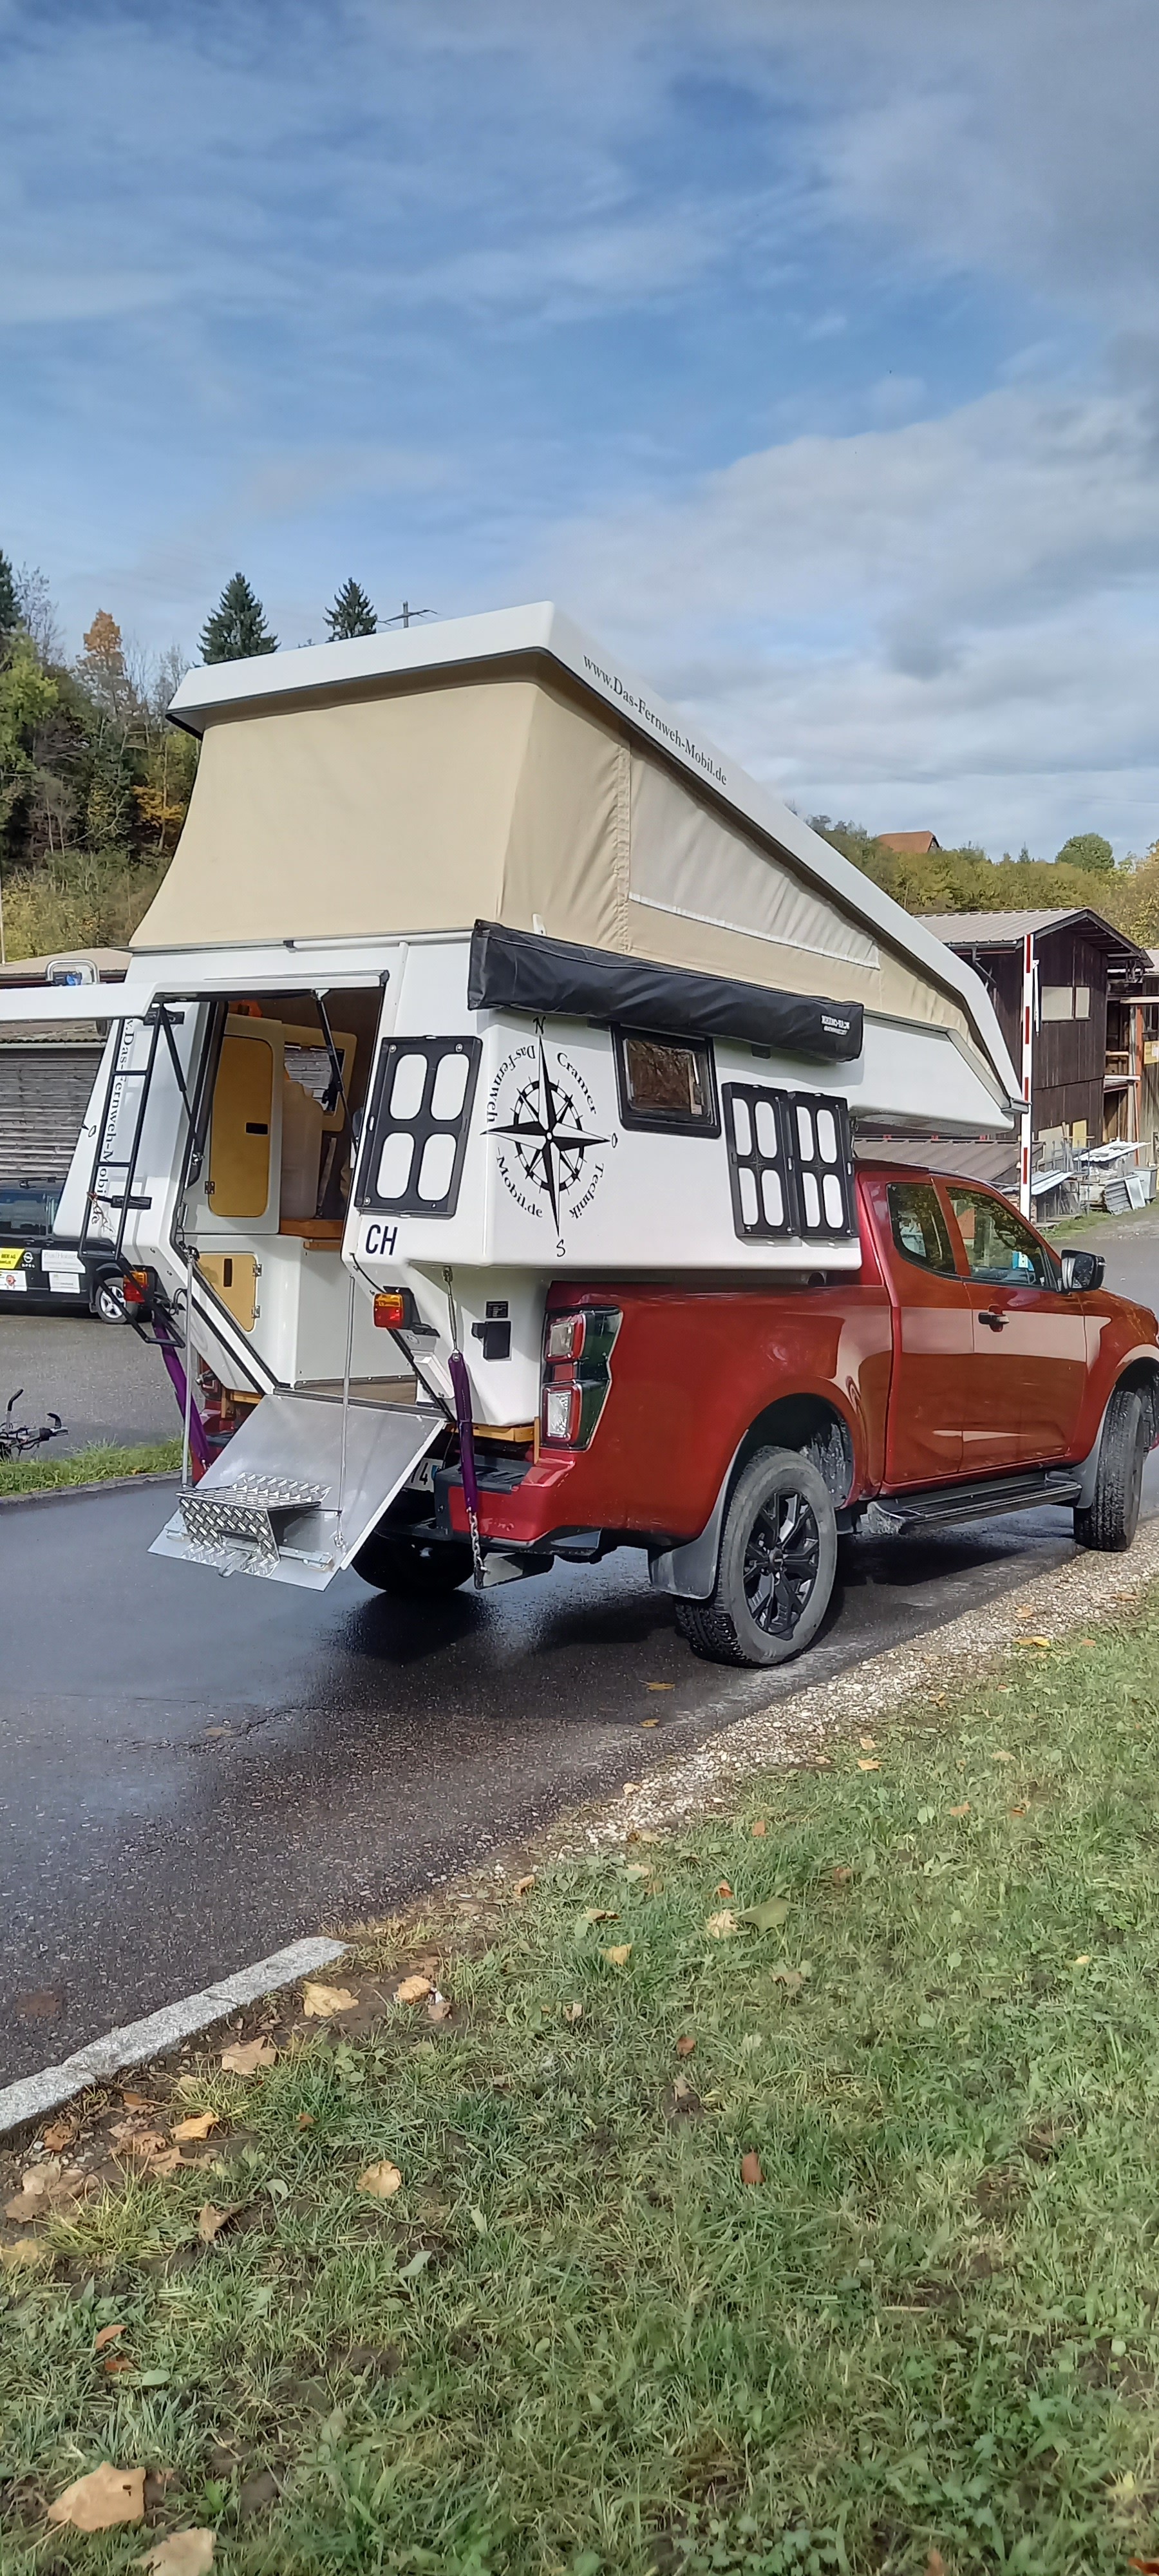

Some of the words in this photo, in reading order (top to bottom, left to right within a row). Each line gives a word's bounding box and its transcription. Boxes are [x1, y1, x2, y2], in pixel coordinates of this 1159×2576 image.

[583, 654, 727, 786] www.Das-Fernweh-Mobil.de
[532, 1016, 546, 1035] N
[557, 1052, 596, 1114] Cramer
[569, 1163, 604, 1219] Technik
[365, 1224, 398, 1256] CH
[556, 1239, 566, 1257] S
